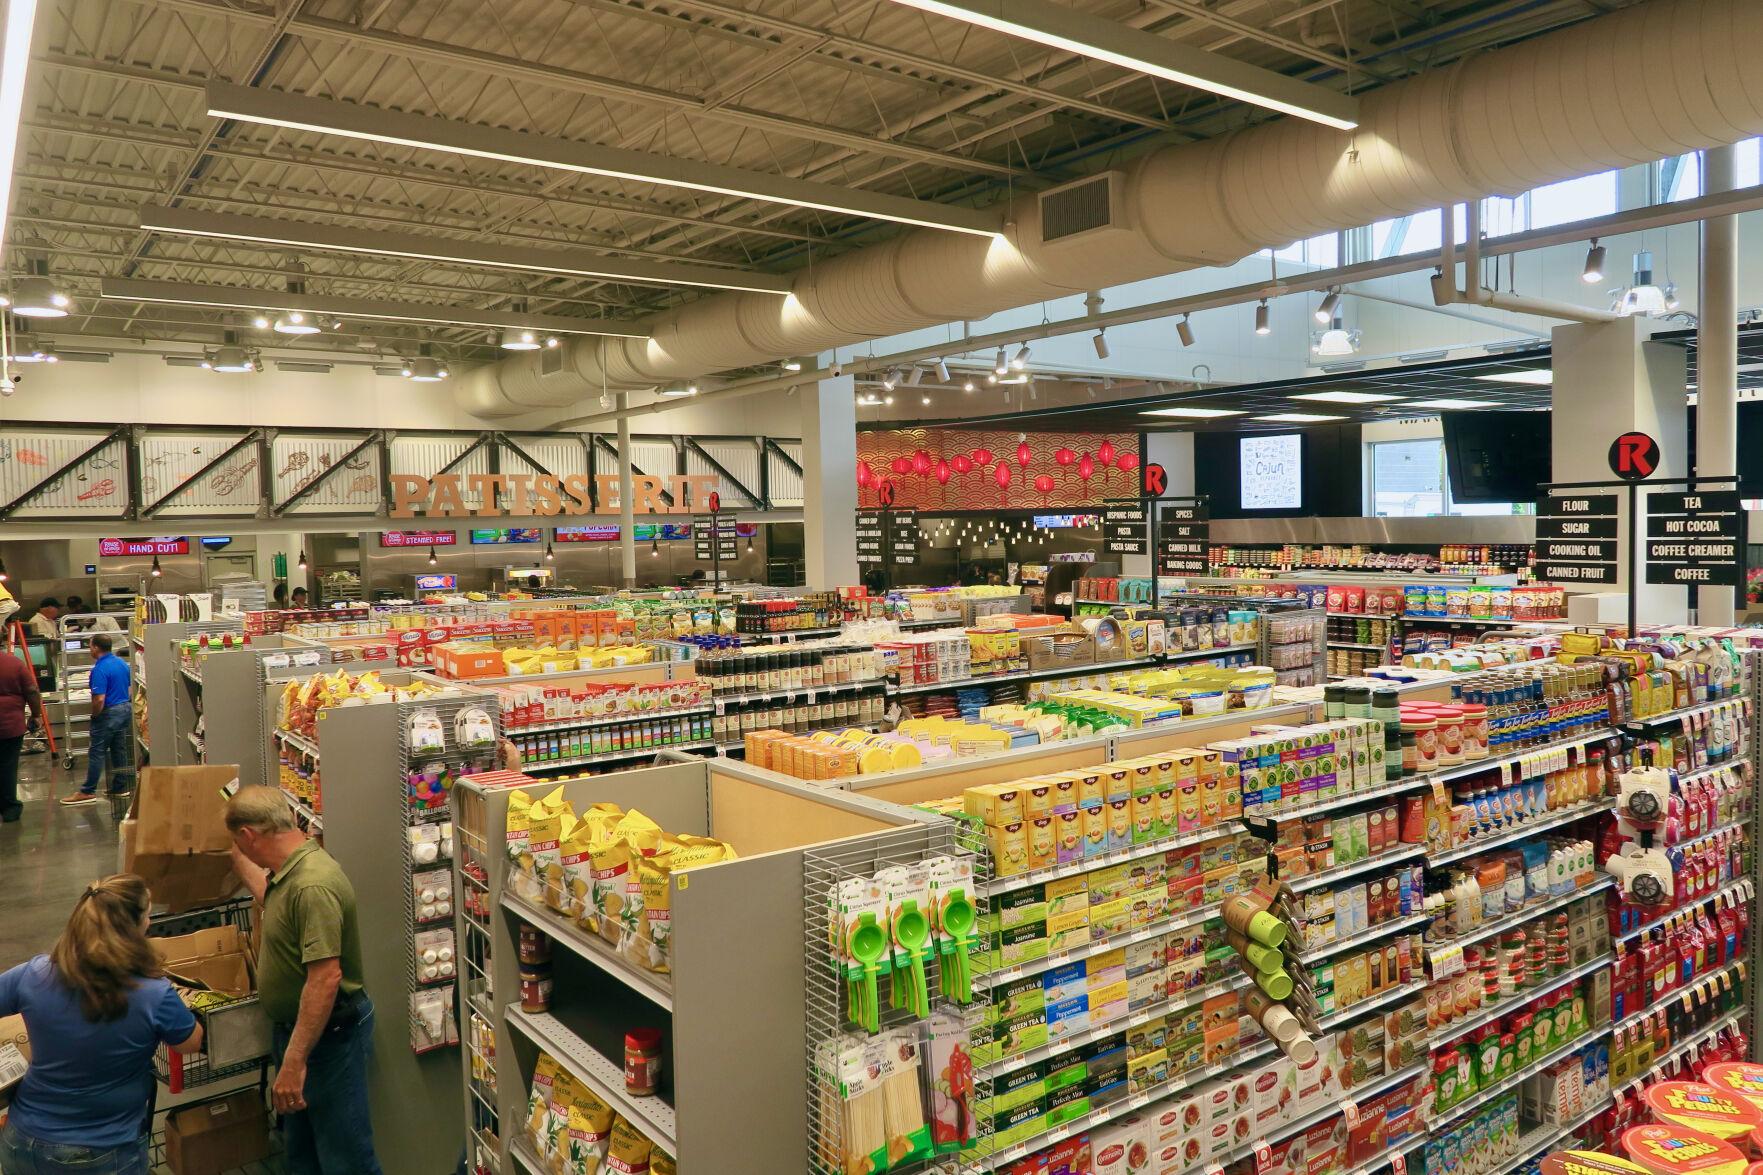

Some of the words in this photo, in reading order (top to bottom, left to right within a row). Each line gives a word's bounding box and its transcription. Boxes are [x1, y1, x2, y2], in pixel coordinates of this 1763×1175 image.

[1618, 435, 1653, 476] R
[1146, 465, 1164, 495] R
[389, 474, 719, 517] PATISSERIE
[880, 480, 891, 503] R
[1562, 501, 1589, 511] FLOUR
[1683, 497, 1702, 509] TEA
[1106, 511, 1127, 519] HISPANIC
[1127, 511, 1143, 519] FOODS
[1175, 510, 1193, 518] SPICES
[1117, 527, 1131, 535] PASTA
[1178, 527, 1190, 536] SALT
[1562, 523, 1589, 533] SUGAR
[1666, 521, 1685, 532] HOT
[1687, 520, 1720, 532] COCOA
[129, 545, 153, 553] HAND
[157, 543, 178, 552] CUT!
[1110, 543, 1124, 551] PASTA
[1124, 543, 1139, 551] SAUCE
[1168, 544, 1188, 552] CANNED
[1188, 544, 1201, 552] MILK
[1549, 545, 1586, 556] COOKING
[1588, 546, 1602, 556] OIL
[1652, 545, 1686, 556] COFFEE
[1688, 544, 1734, 556] CREAMER
[1166, 560, 1185, 569] BAKING
[1185, 561, 1203, 570] GOODS
[1546, 567, 1579, 578] CANNED
[1581, 568, 1605, 579] FRUIT
[1674, 569, 1710, 580] COFFEE
[420, 805, 449, 816] BALLOONS
[542, 841, 556, 849] CHIPS
[674, 855, 705, 864] CLASSIC
[1014, 897, 1035, 906] Jasmine
[1015, 933, 1036, 942] Jasmine
[1053, 972, 1079, 984] Peppermint
[1007, 986, 1026, 997] GREEN
[1026, 982, 1036, 990] TEA
[1056, 1006, 1082, 1018] Peppermint
[1009, 1022, 1028, 1033] GREEN
[1028, 1018, 1039, 1026] TEA
[1008, 1075, 1027, 1088] GREEN
[1027, 1071, 1038, 1080] TEA
[1387, 1091, 1409, 1105] Luzianne
[1558, 1077, 1570, 1120] tempt
[1010, 1111, 1028, 1123] GREEN
[1028, 1107, 1039, 1116] TEA
[1360, 1104, 1385, 1123] uzianne
[1389, 1118, 1410, 1133] Luzianne
[1049, 1148, 1074, 1163] uzianne
[1309, 1155, 1332, 1172] Luzianne
